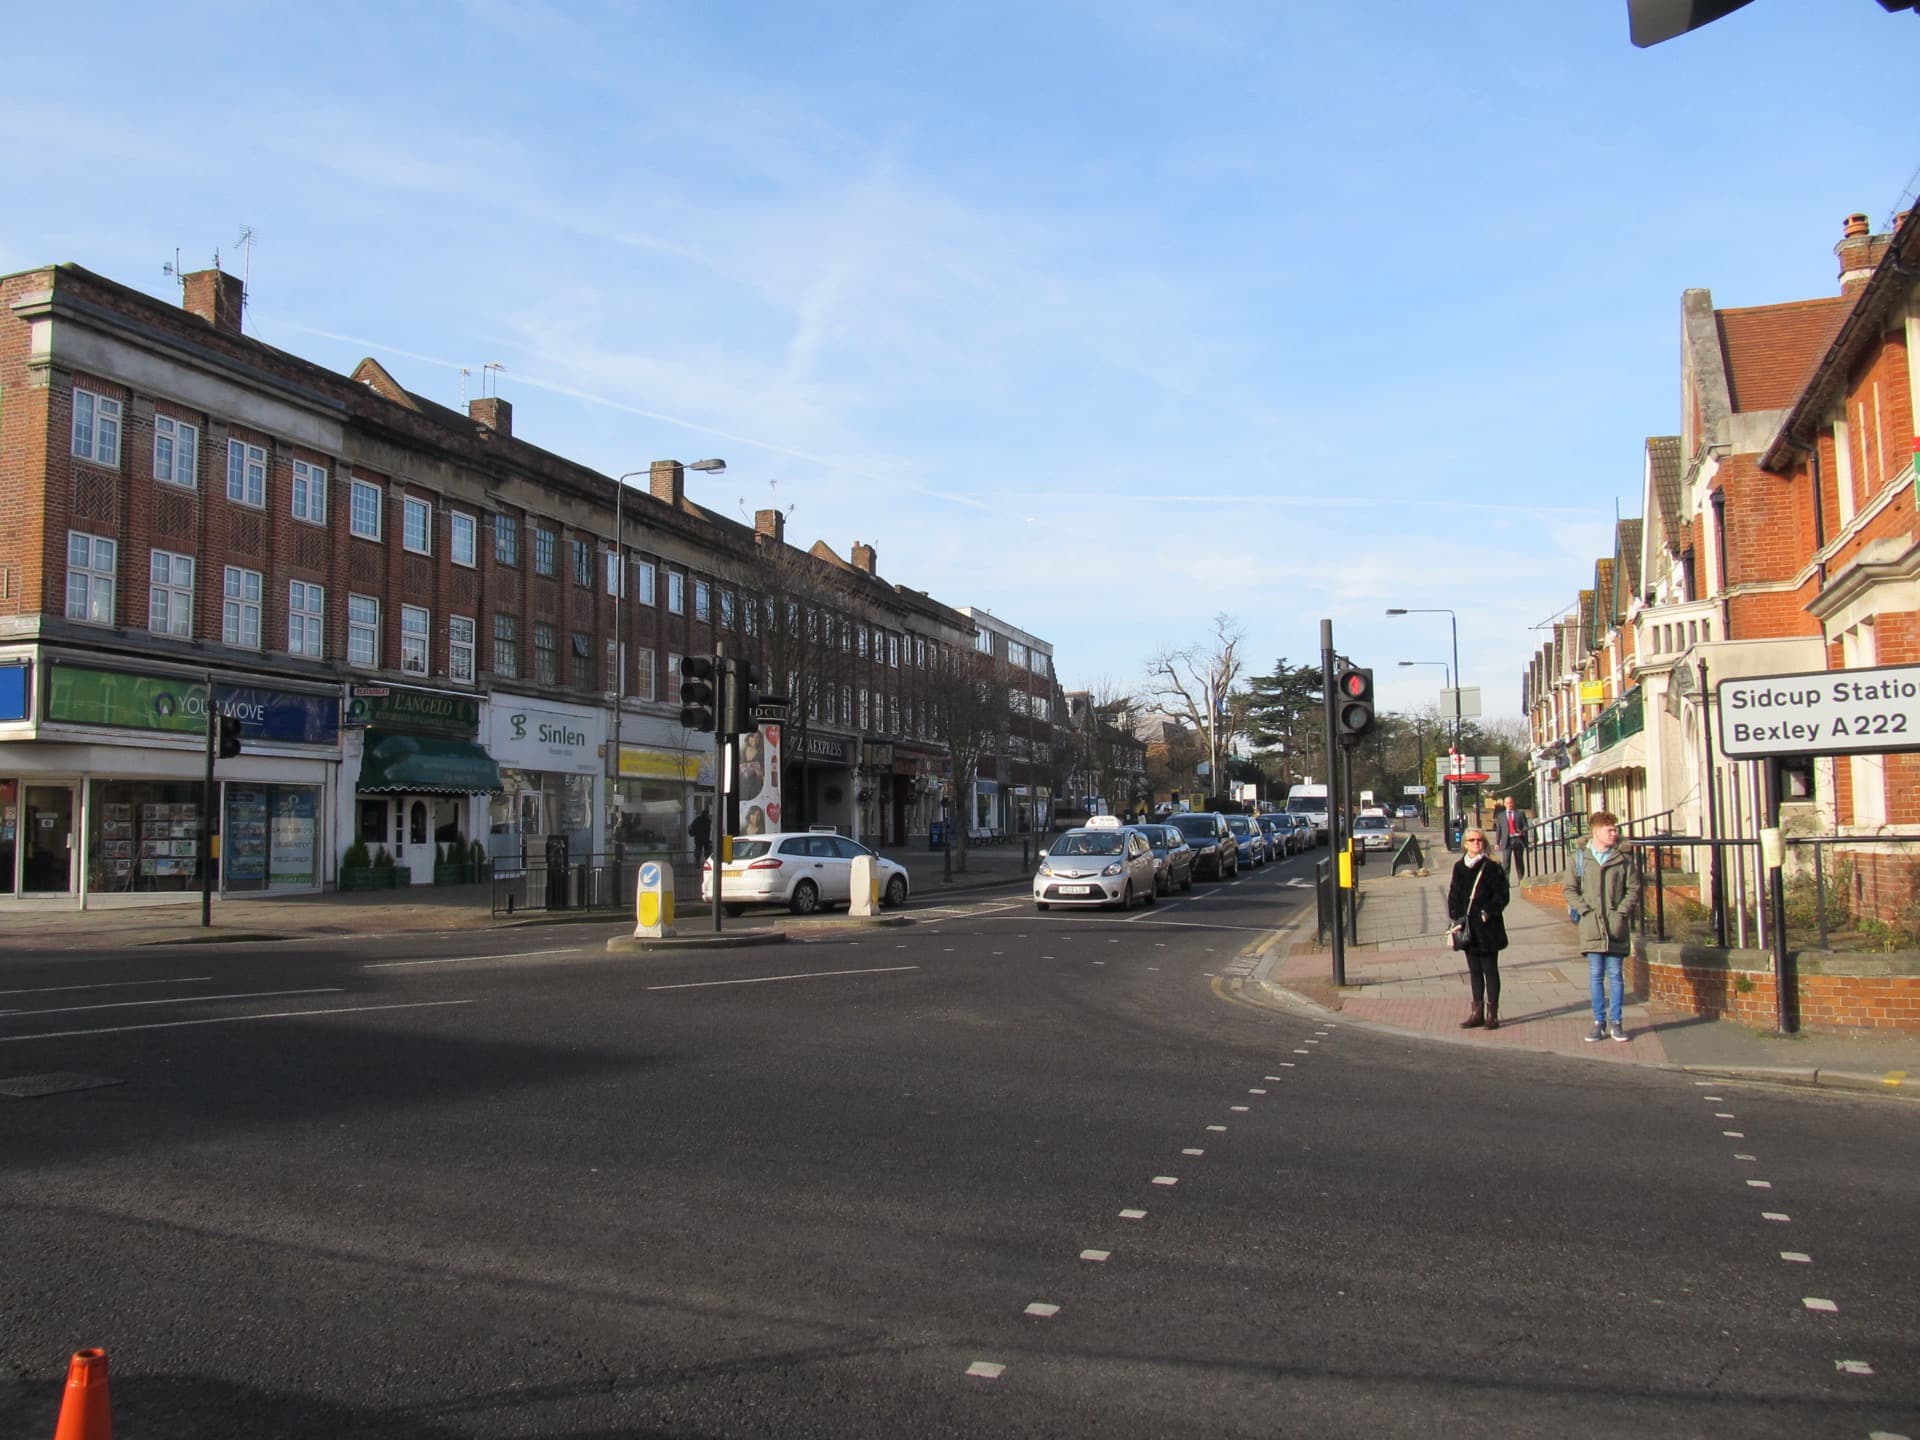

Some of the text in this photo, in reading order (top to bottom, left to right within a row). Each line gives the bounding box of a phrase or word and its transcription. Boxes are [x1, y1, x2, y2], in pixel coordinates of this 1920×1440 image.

[1731, 679, 1920, 709] Sidcup Statio
[223, 703, 264, 721] MOVE
[538, 723, 585, 747] Sinlen
[1734, 713, 1908, 742] Bexley A222
